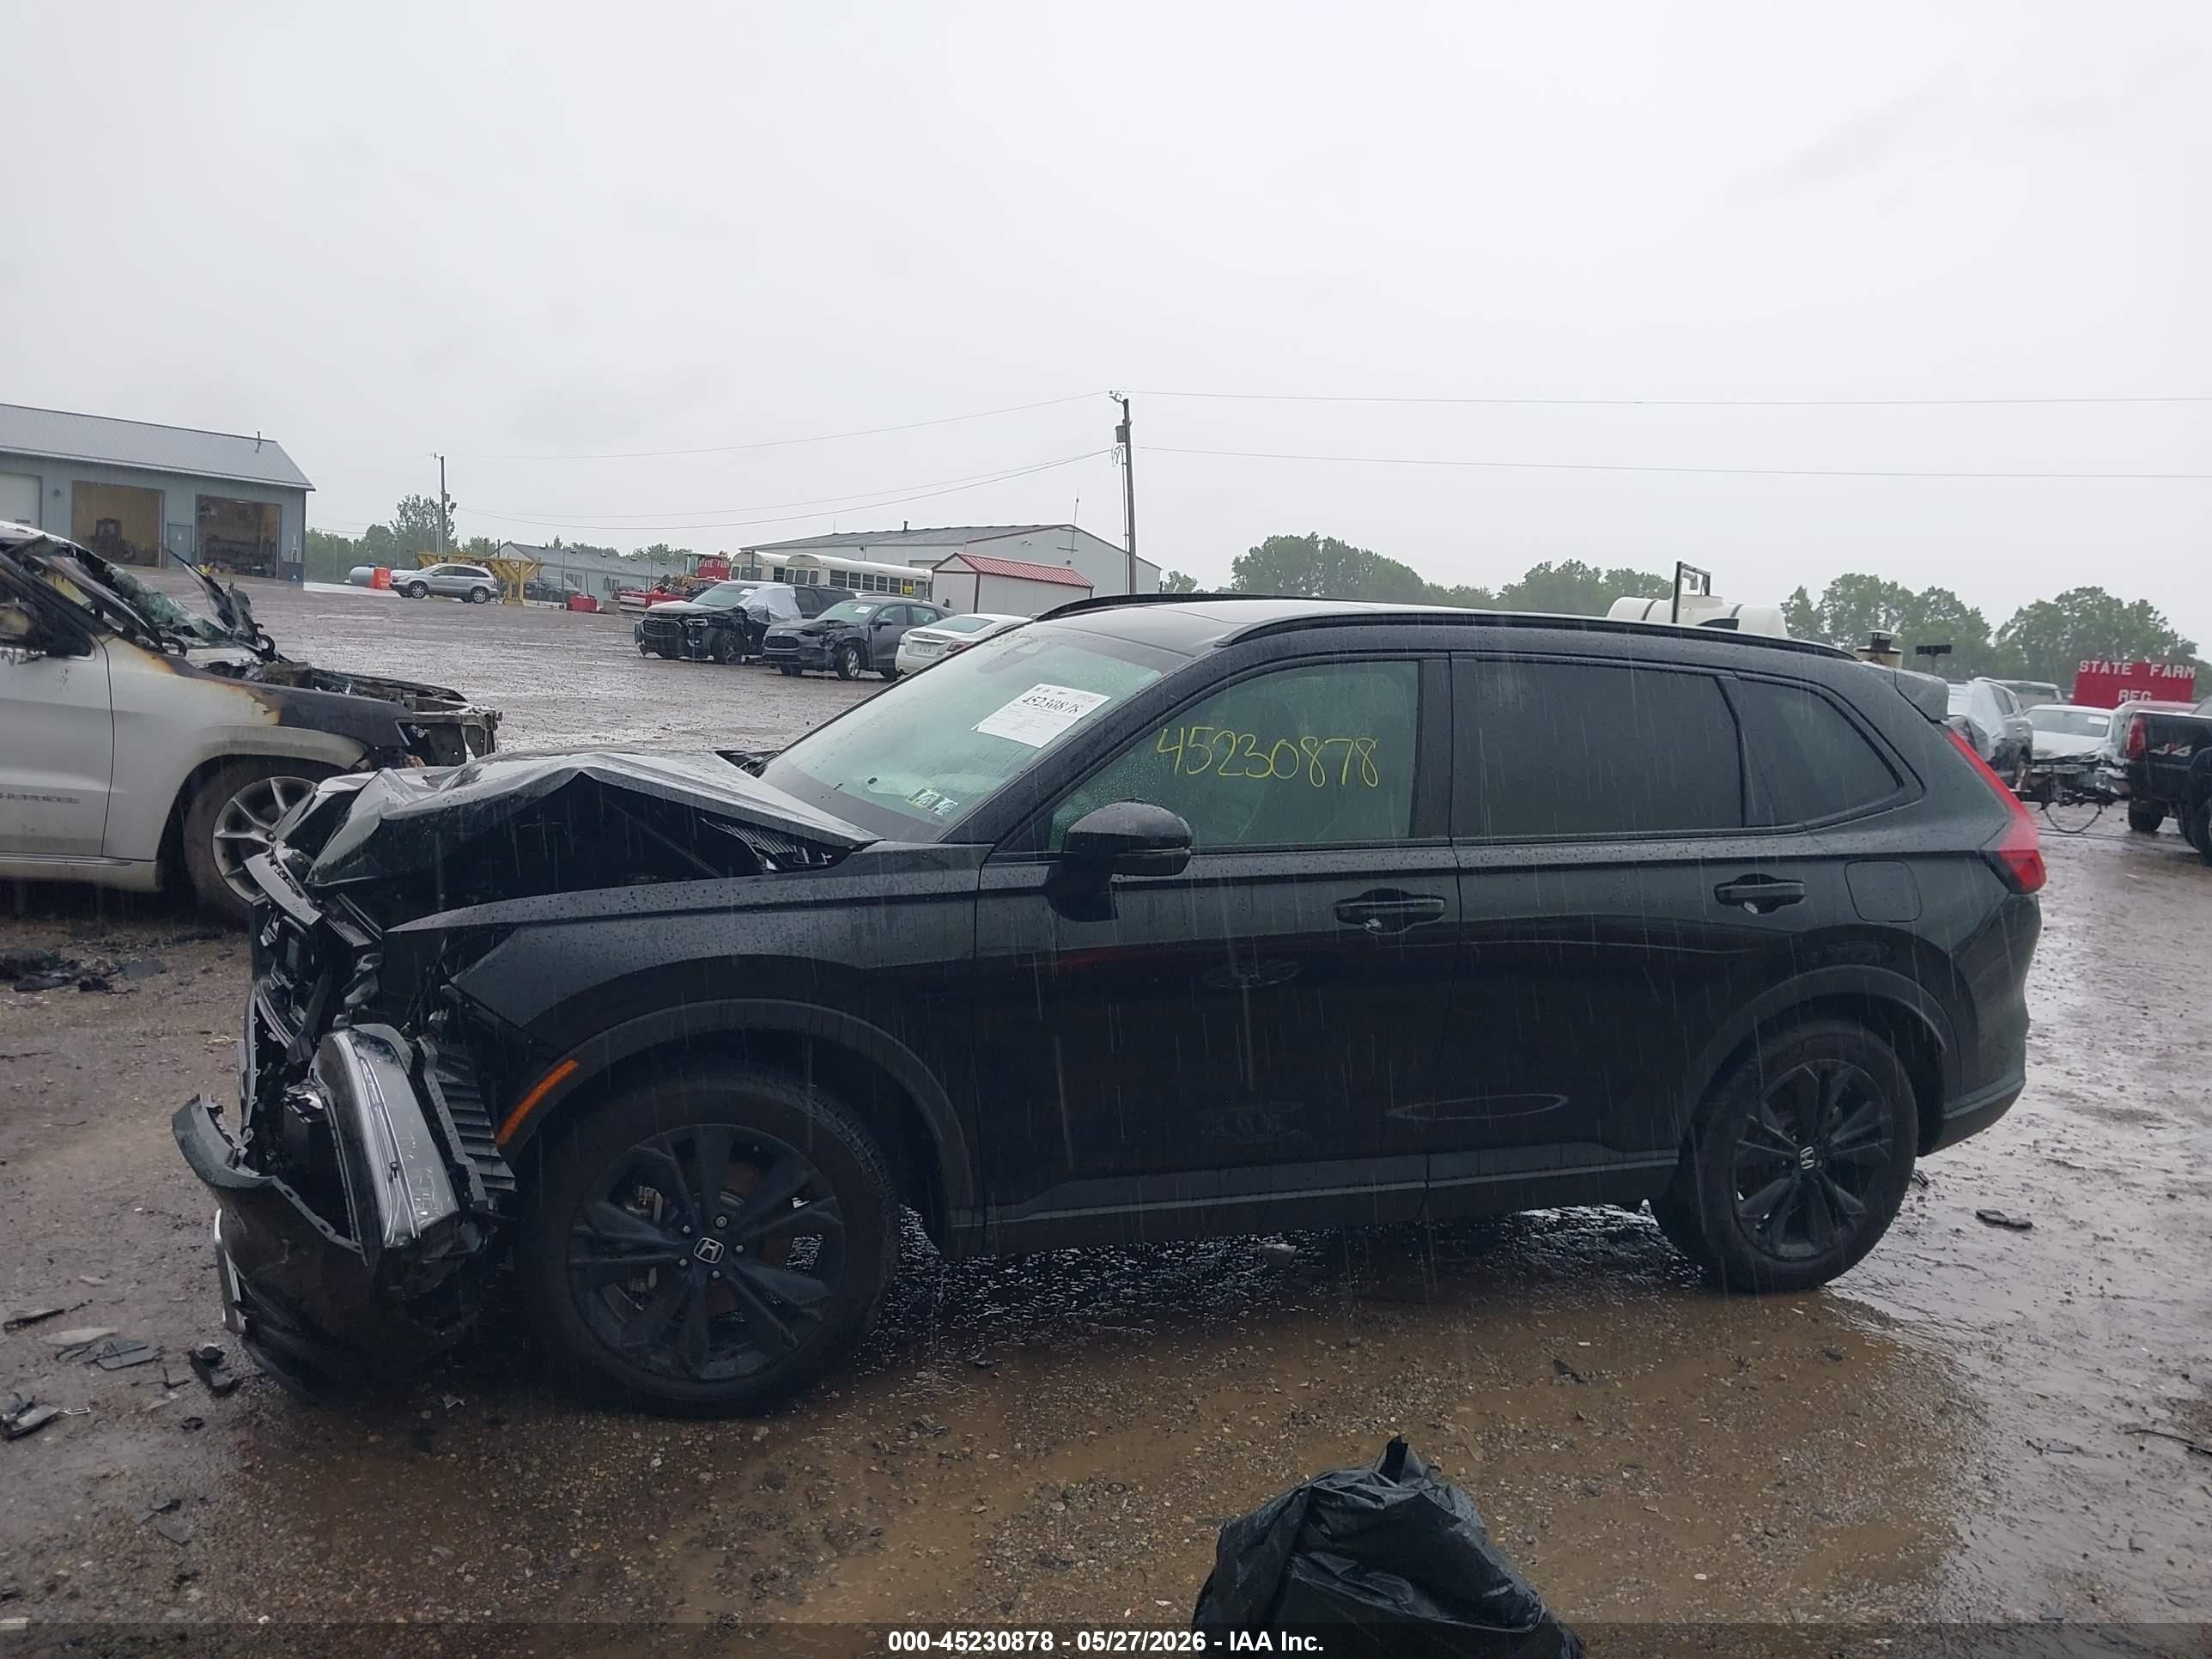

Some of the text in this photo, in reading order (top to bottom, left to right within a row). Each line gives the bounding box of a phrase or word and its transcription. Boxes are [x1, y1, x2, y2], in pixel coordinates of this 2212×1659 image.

[2078, 659, 2197, 679] STATE FARM
[1156, 726, 1379, 788] 45230878
